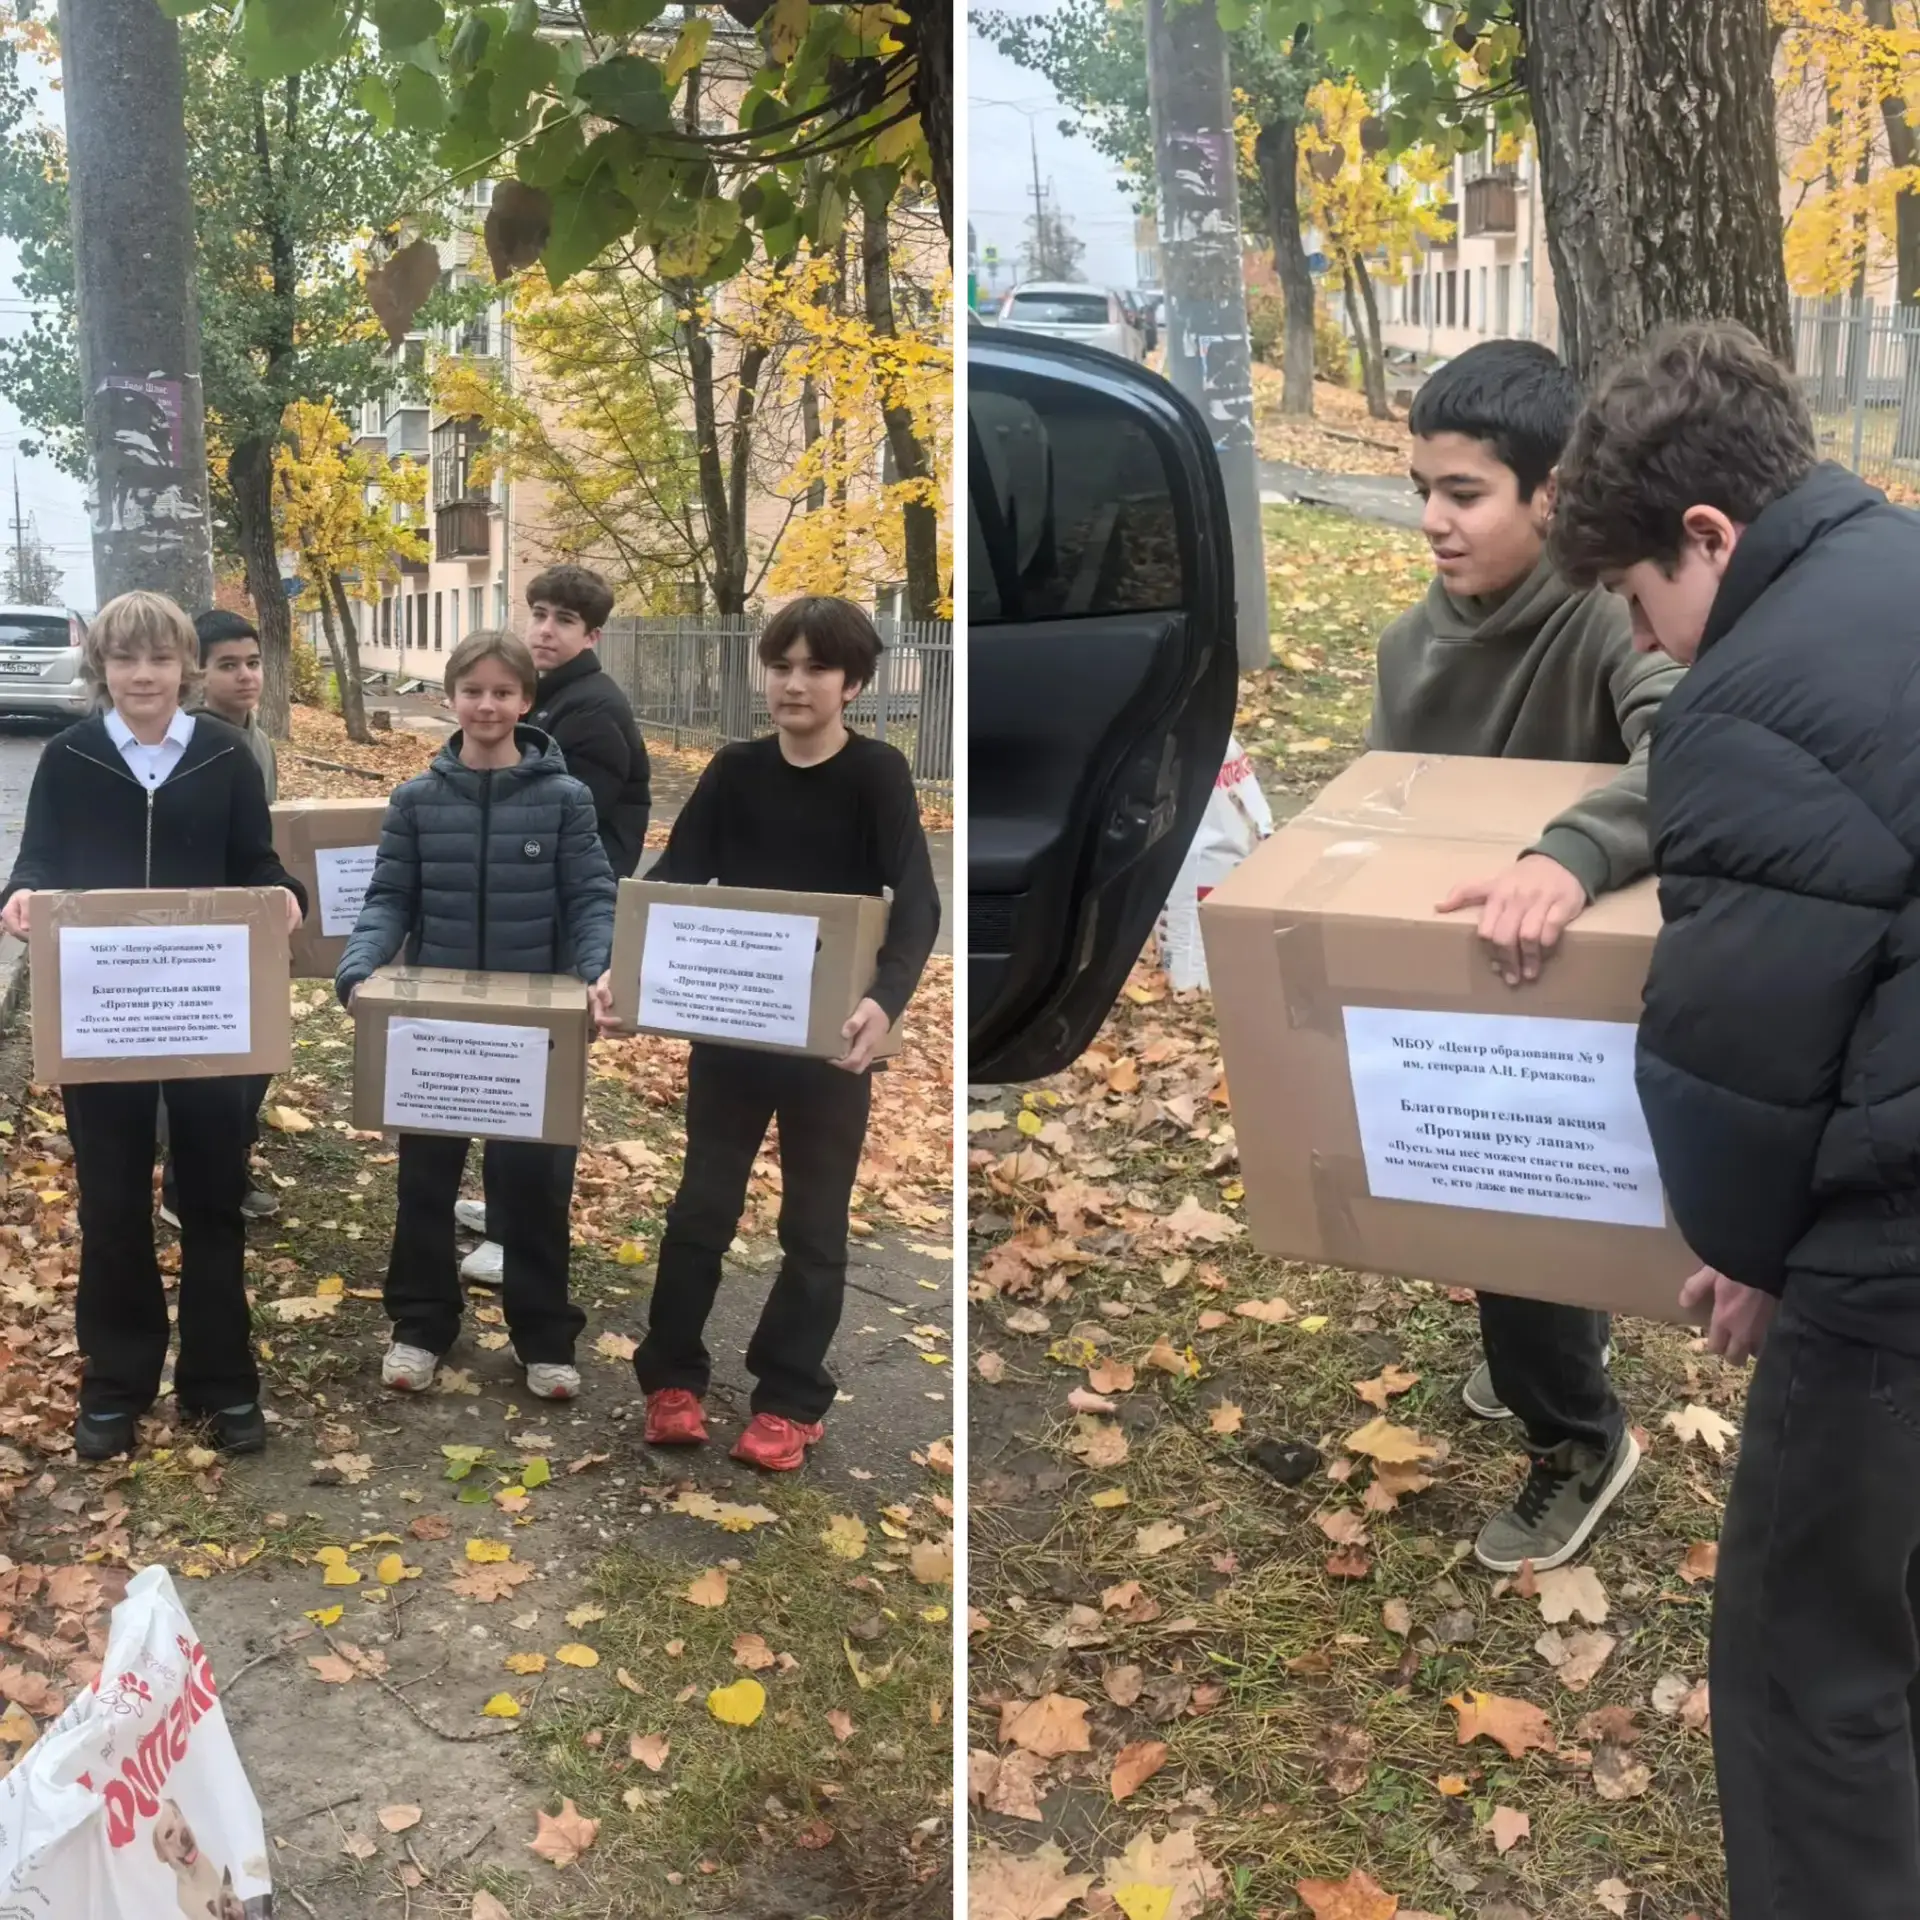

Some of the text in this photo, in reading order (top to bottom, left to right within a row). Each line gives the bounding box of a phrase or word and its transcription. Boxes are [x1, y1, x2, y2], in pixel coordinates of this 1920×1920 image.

[1392, 1037, 1604, 1064] МБОУ «Центр образования № 9
[1403, 1060, 1424, 1069] им.
[1428, 1061, 1485, 1075] генерала
[1521, 1068, 1595, 1084] Ермакова»
[1401, 1099, 1606, 1131] Благотворительная акция
[1416, 1123, 1594, 1152] «Протяни руку лапам»
[1389, 1140, 1432, 1155] «Пусть
[1436, 1146, 1455, 1157] мы
[1484, 1150, 1526, 1164] можем
[1530, 1156, 1573, 1168] спасти
[1577, 1160, 1609, 1175] всех,
[1613, 1166, 1629, 1175] но
[1386, 1156, 1404, 1166] мы
[1408, 1159, 1449, 1171] можем
[1453, 1163, 1494, 1175] спасти
[1499, 1168, 1551, 1183] намного
[1612, 1182, 1638, 1191] чем
[1451, 1178, 1472, 1189] кто
[1476, 1179, 1506, 1194] даже
[1510, 1186, 1524, 1195] не
[1528, 1186, 1591, 1201] пытался»
